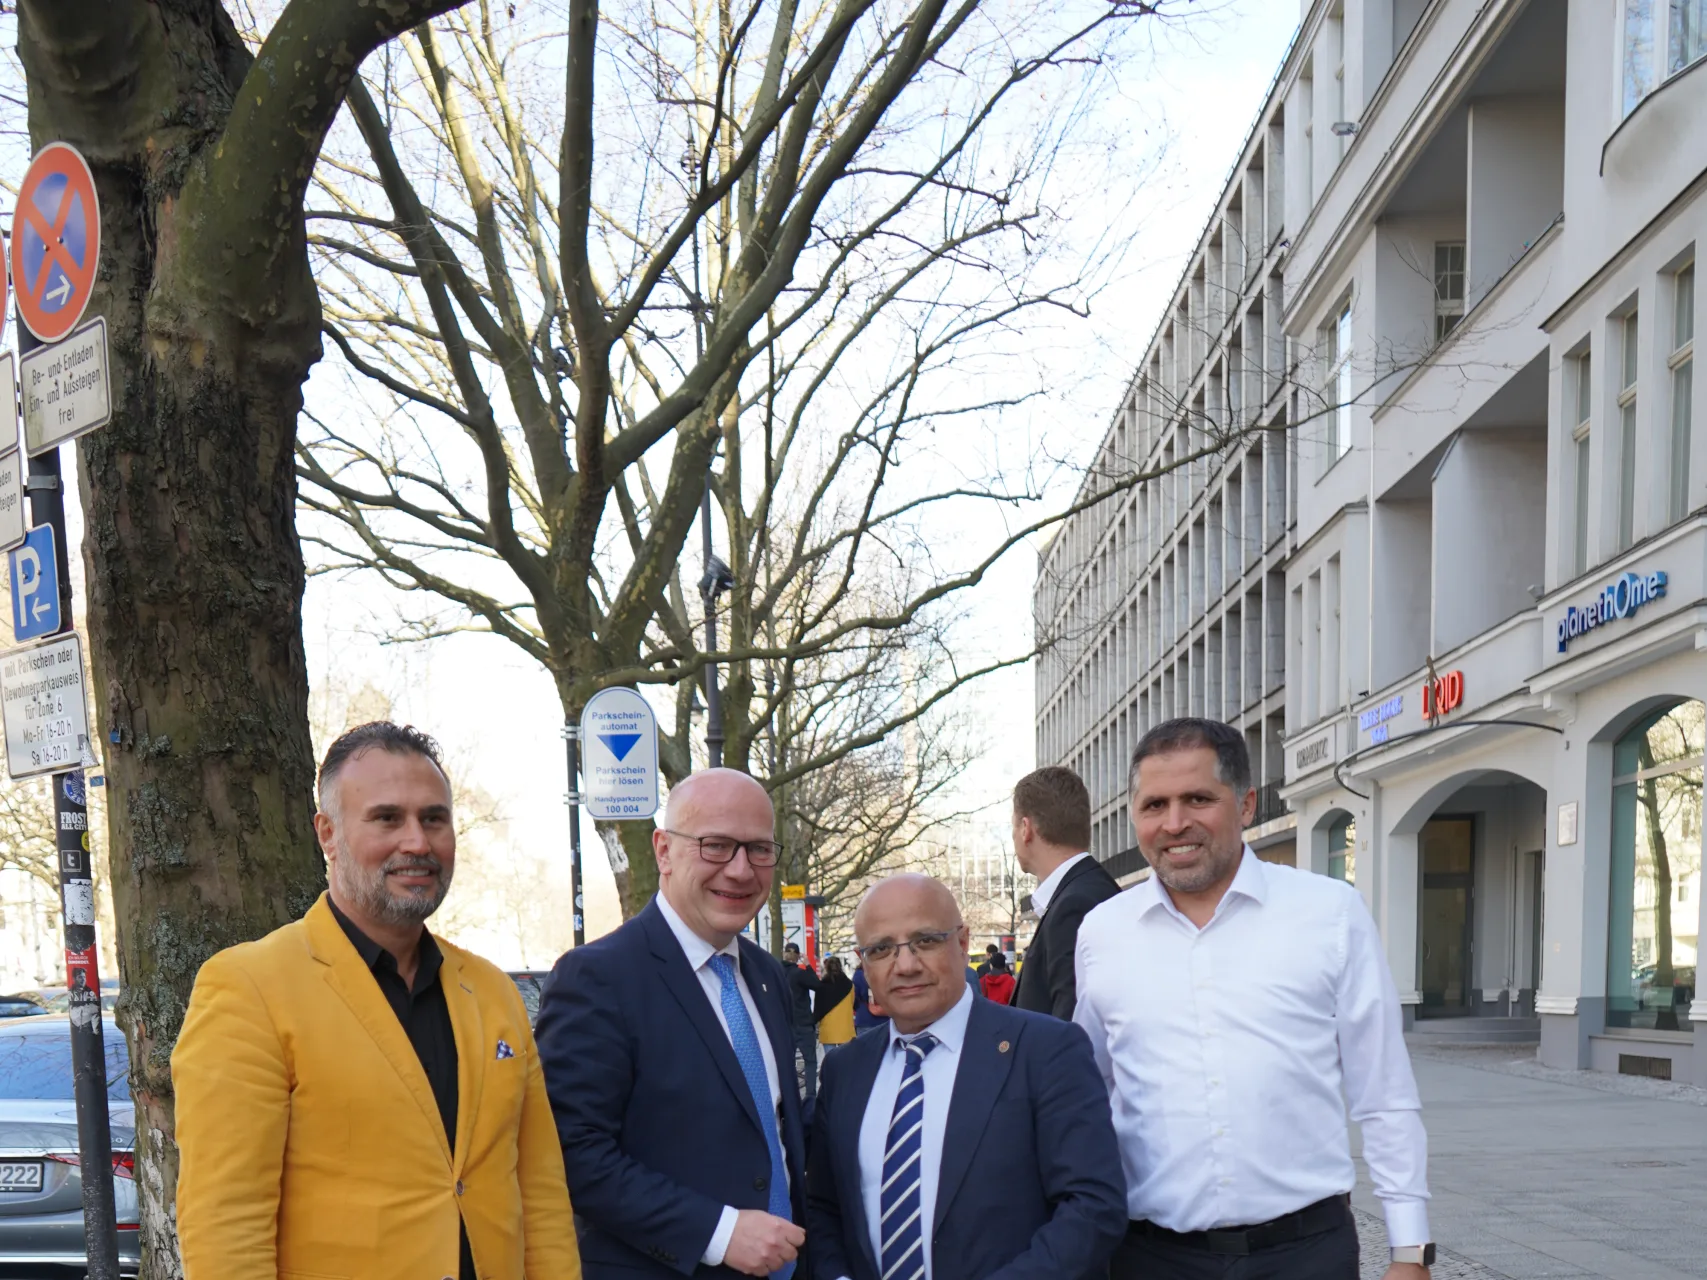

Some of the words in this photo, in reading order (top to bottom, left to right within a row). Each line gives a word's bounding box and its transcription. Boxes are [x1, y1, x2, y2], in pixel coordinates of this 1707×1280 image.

[32, 369, 45, 386] Be-
[48, 357, 61, 378] und
[63, 345, 94, 371] Entladen
[30, 395, 44, 413] Ein-
[47, 385, 60, 404] und
[63, 368, 101, 398] Aussteigen
[59, 402, 75, 425] frei
[15, 546, 41, 627] P
[5, 661, 16, 678] mit
[18, 651, 55, 675] Parkschein
[57, 647, 73, 664] oder
[4, 669, 79, 702] Bewohnerparkausweis
[1422, 670, 1464, 720] LQID
[25, 704, 35, 720] für
[38, 702, 54, 717] Zone
[57, 697, 62, 712] 6
[592, 711, 645, 721] Parkschein-
[23, 726, 44, 744] Mo-Fr
[46, 720, 65, 738] 16-20
[66, 718, 72, 733] h
[601, 722, 637, 730] automat
[31, 750, 40, 766] Sa
[42, 745, 61, 762] 16-20
[63, 744, 68, 759] h
[596, 766, 646, 774] Parkschein
[599, 777, 616, 785] hier
[618, 777, 644, 785] lösen
[594, 795, 649, 803] Handyparkzone
[606, 805, 621, 813] 100
[623, 805, 639, 813] 004
[60, 811, 86, 824] FROST
[0, 1165, 38, 1185] 222
